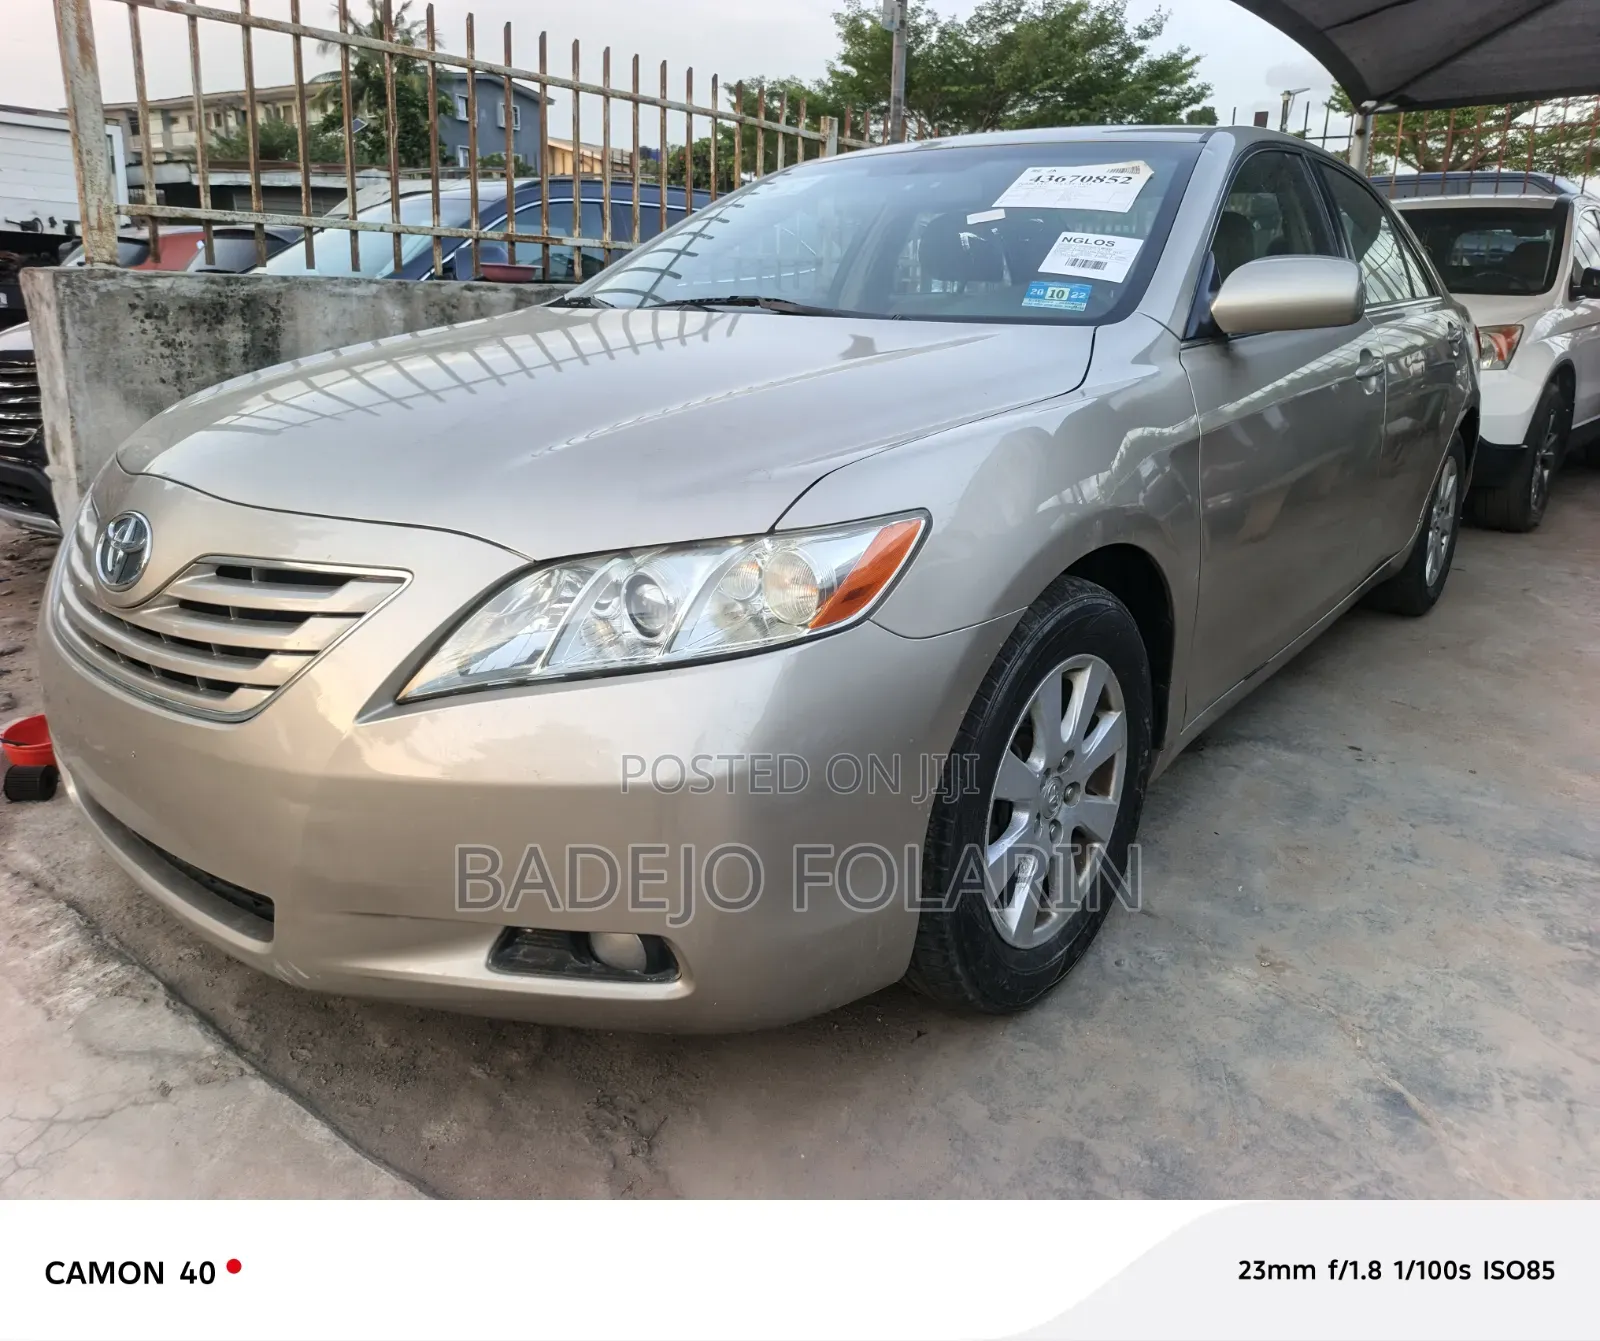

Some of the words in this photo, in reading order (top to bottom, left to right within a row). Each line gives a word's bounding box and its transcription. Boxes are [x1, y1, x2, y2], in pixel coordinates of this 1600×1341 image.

[1029, 174, 1133, 184] 43670852
[1061, 236, 1116, 248] NGLOS
[1030, 288, 1044, 296] 20
[1048, 289, 1065, 299] 10
[1070, 291, 1086, 299] 22
